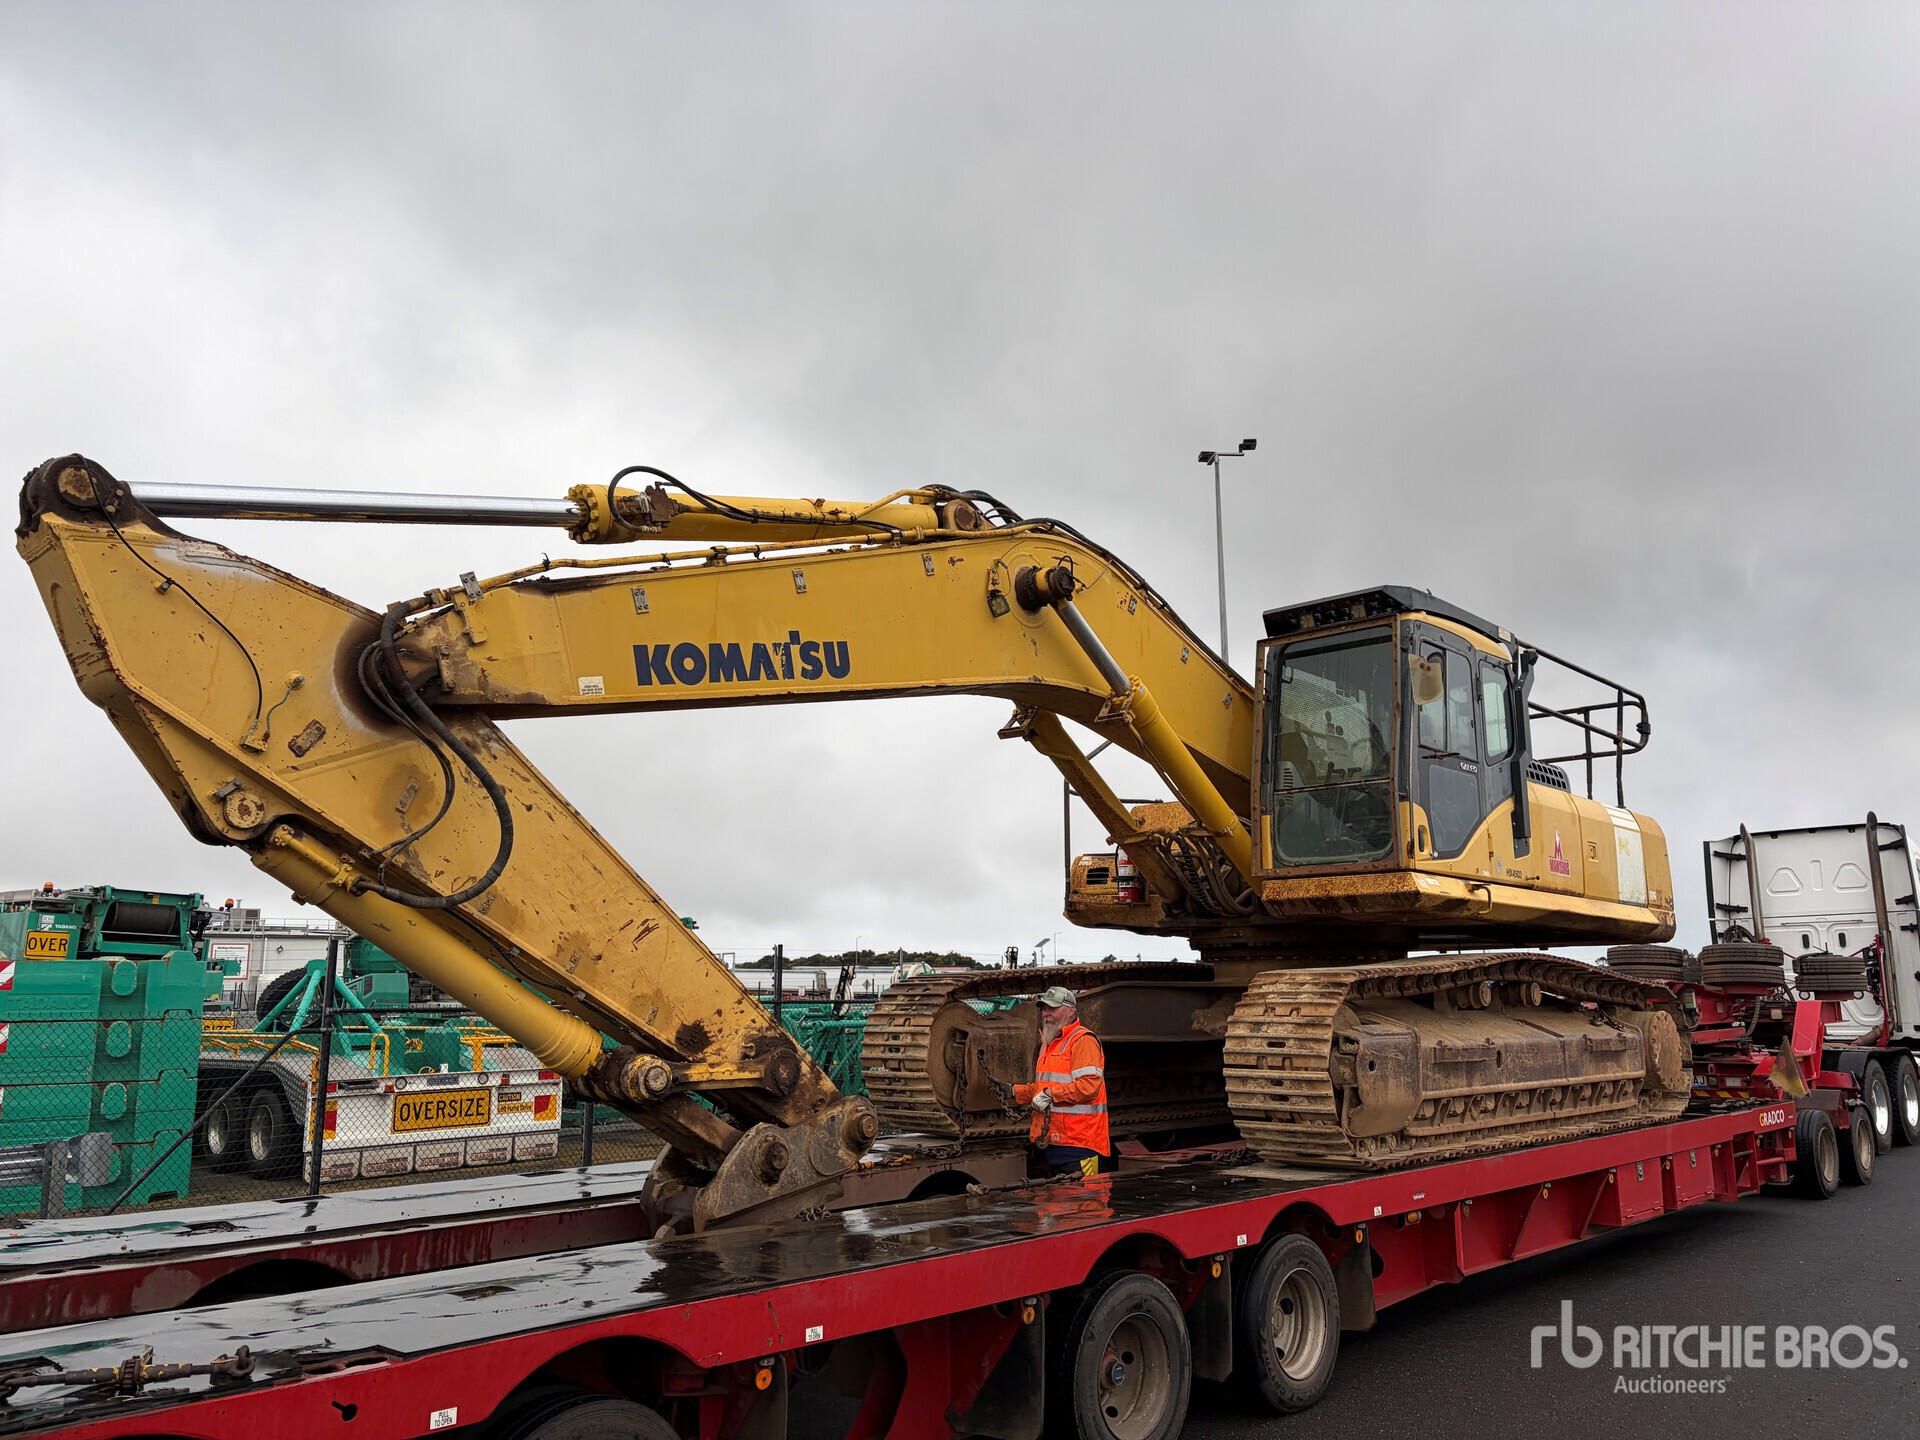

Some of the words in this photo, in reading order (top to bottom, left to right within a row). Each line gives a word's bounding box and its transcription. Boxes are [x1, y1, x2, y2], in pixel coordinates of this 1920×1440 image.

[632, 630, 851, 687] KOMATSU
[28, 937, 68, 952] OVER
[400, 1097, 485, 1122] OVERSIZE
[1759, 1109, 1785, 1127] GRADCO
[434, 1419, 441, 1427] TO
[441, 1417, 453, 1426] OPEN
[438, 1410, 450, 1419] PULL
